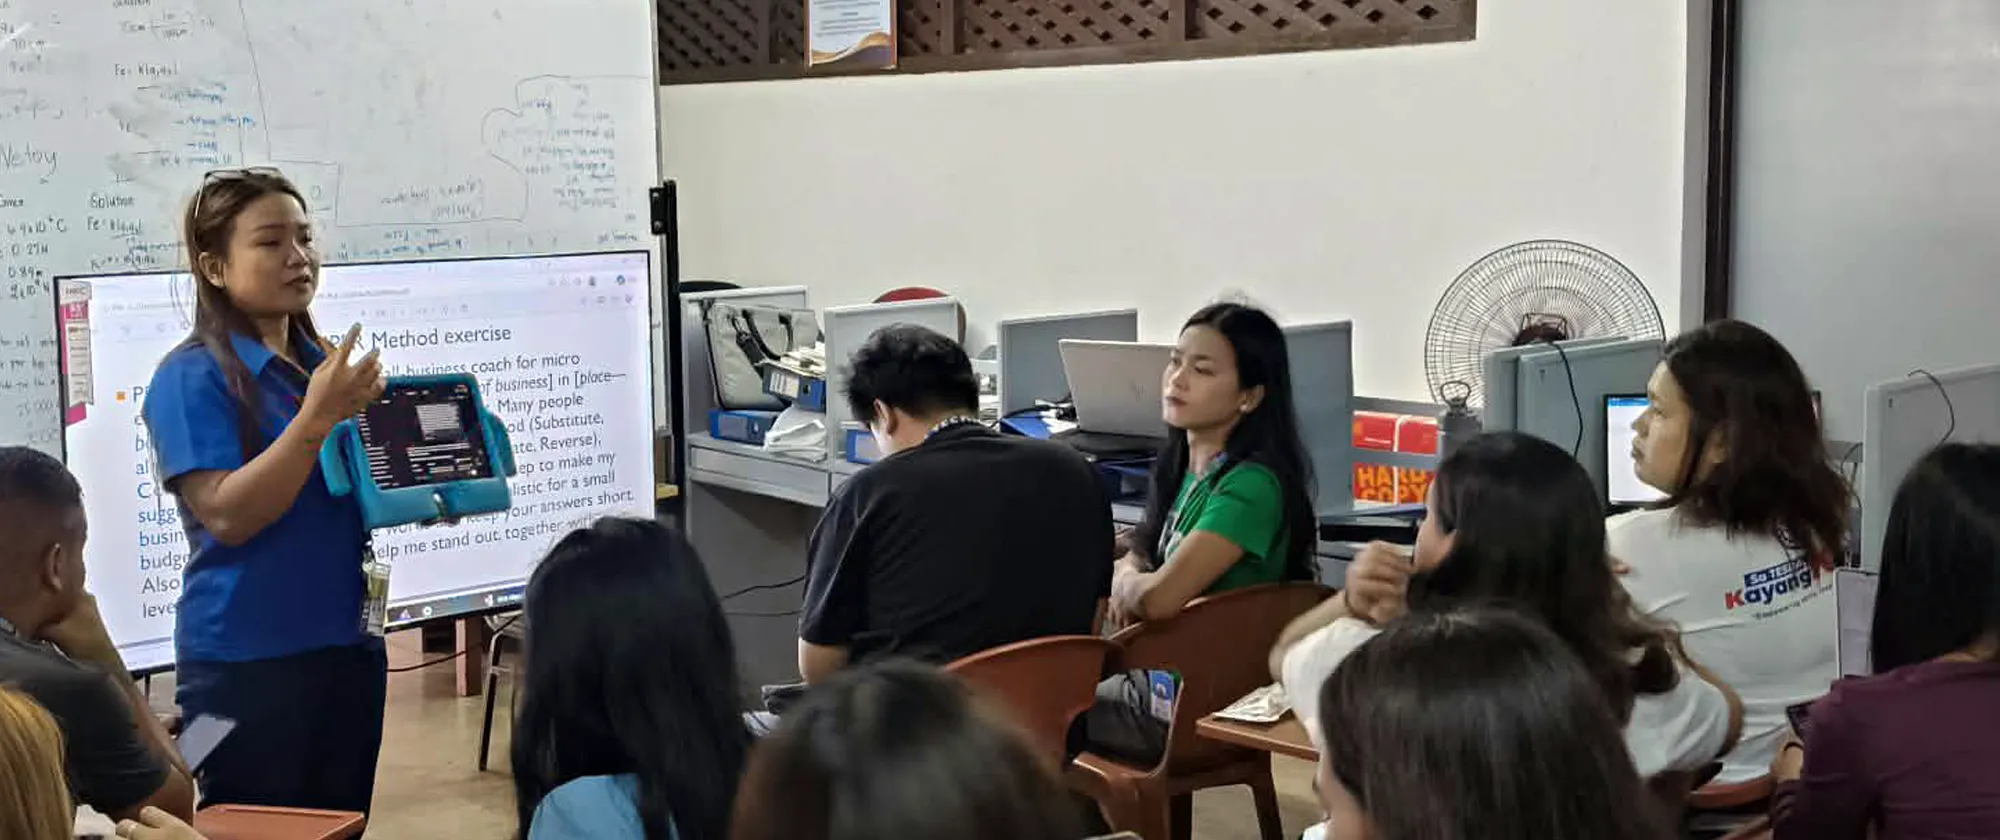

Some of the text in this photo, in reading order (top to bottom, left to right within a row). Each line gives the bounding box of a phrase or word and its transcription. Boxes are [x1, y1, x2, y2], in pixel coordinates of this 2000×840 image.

[371, 327, 438, 350] Method
[445, 326, 512, 344] exercise
[471, 356, 512, 374] coach
[516, 354, 537, 370] for
[541, 353, 581, 368] micro
[558, 373, 570, 387] in
[498, 393, 584, 415] Many people
[507, 417, 525, 434] od
[519, 452, 616, 478] ep to make my
[513, 470, 615, 497] listic for a small
[138, 507, 178, 526] sugg
[505, 504, 537, 523] your
[541, 495, 593, 513] answers
[139, 529, 184, 547] busin
[377, 543, 399, 561] elp
[404, 541, 427, 555] me
[431, 532, 470, 551] stand
[505, 519, 563, 541] together
[141, 576, 180, 594] Also
[1750, 571, 1767, 585] Sa
[1725, 569, 1812, 609] Kayang
[142, 602, 178, 618] leve
